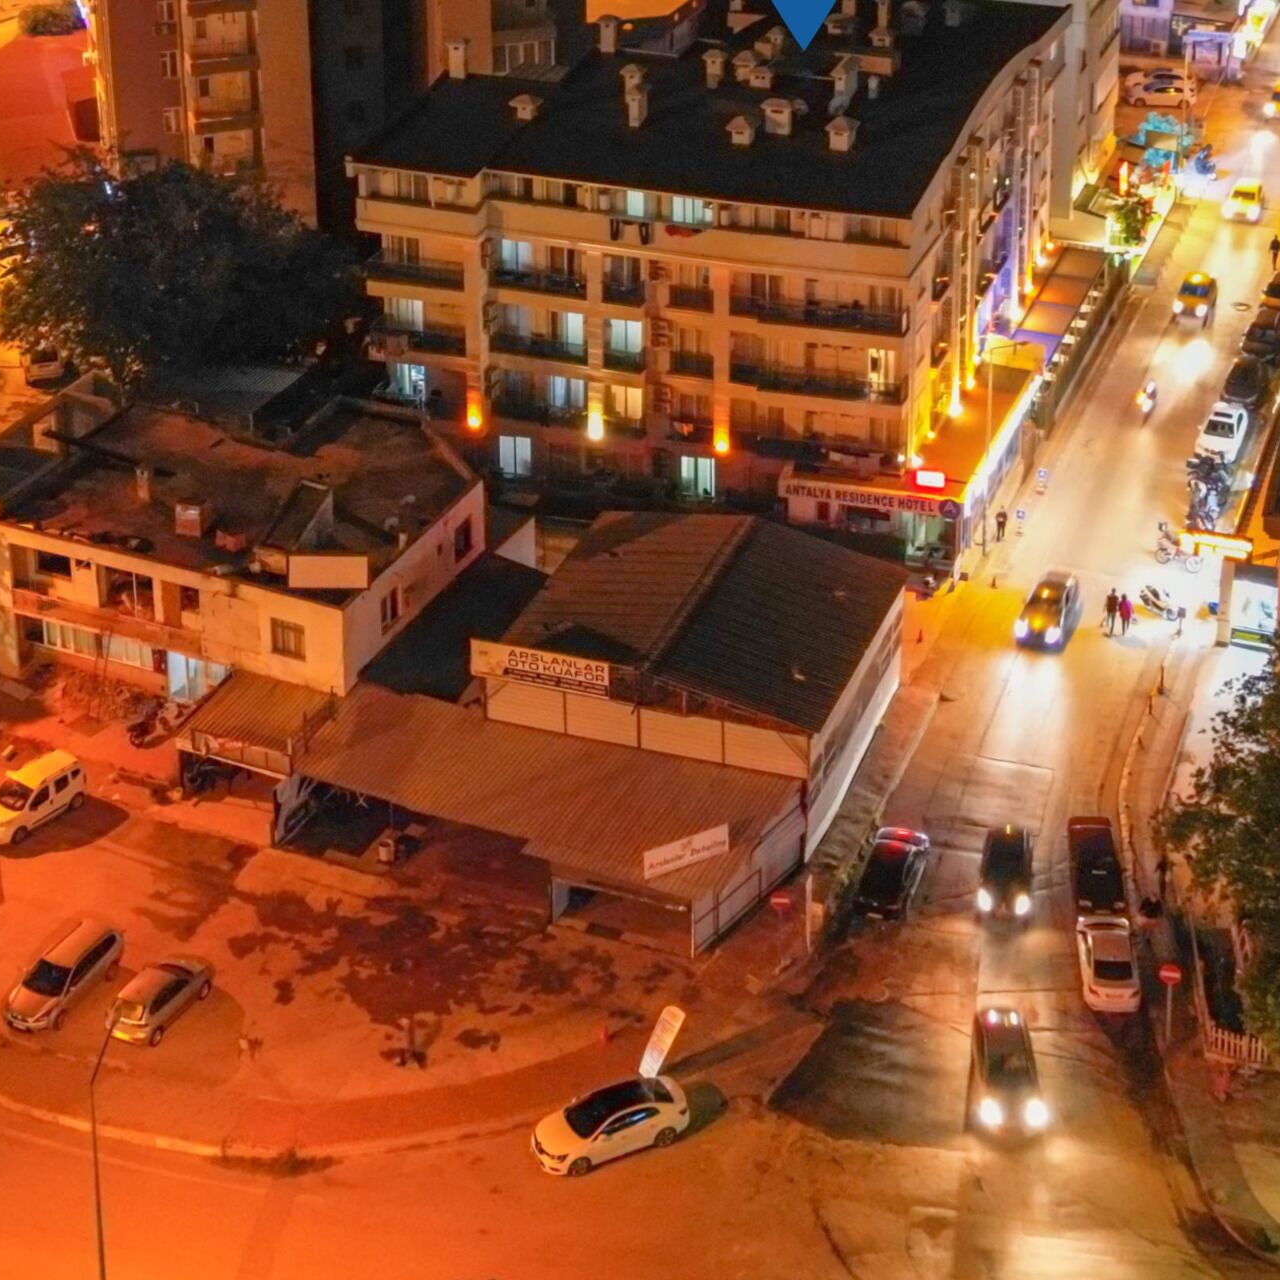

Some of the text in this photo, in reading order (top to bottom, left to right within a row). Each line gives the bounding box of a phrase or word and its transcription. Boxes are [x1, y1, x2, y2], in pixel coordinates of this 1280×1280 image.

[785, 484, 934, 513] ANTALYA RESIDENCE HOTEL
[508, 649, 605, 674] ARSLANLAR
[508, 658, 539, 672] OTO
